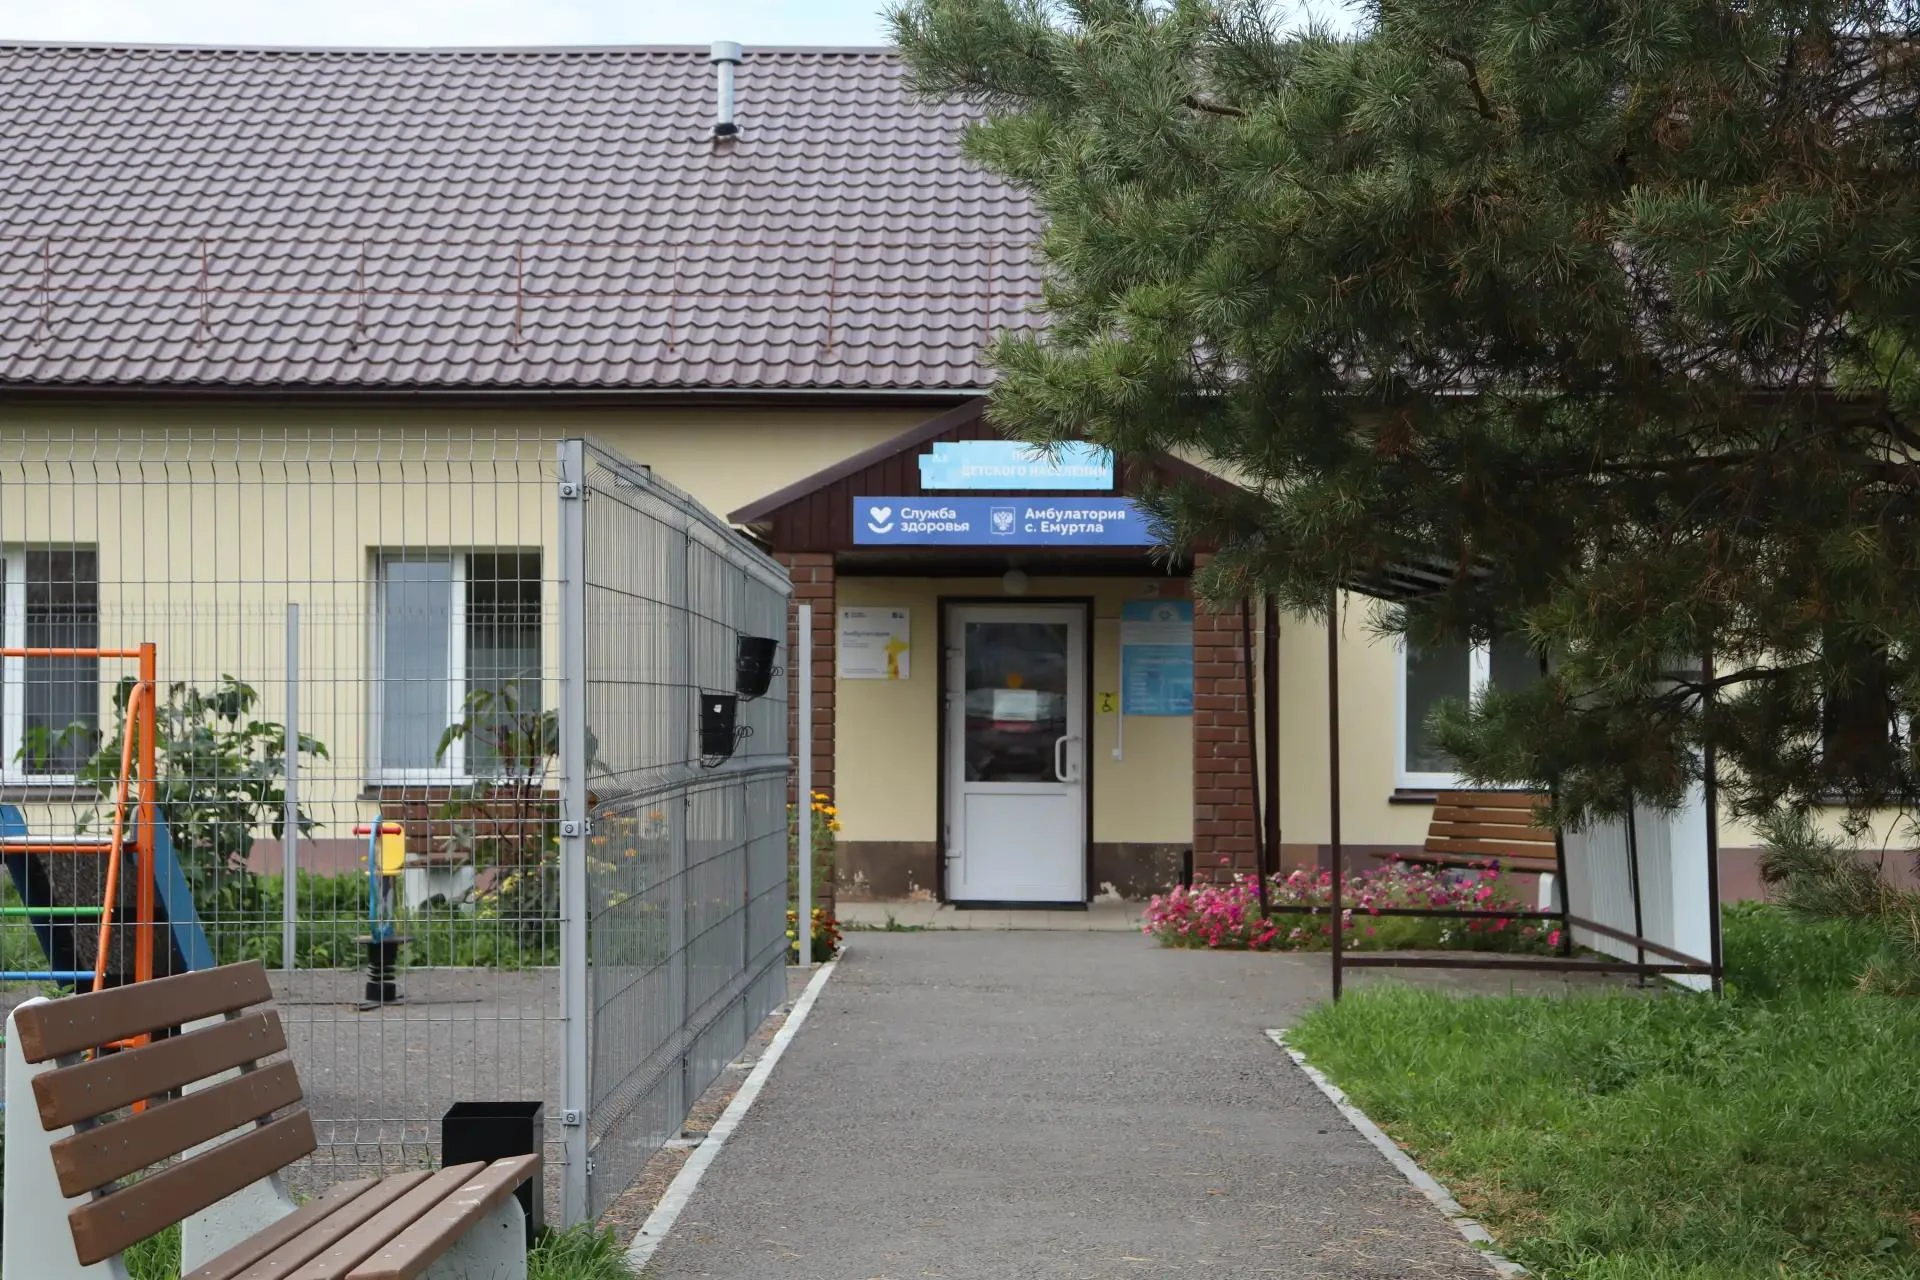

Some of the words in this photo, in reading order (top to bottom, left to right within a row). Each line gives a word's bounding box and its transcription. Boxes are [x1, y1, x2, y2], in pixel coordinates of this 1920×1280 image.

[962, 465, 1026, 477] ДЕТСКОГО
[901, 508, 956, 522] Служба
[1025, 508, 1125, 523] Амбулатория
[901, 521, 969, 534] здоровья
[1025, 524, 1036, 533] с.
[1041, 522, 1104, 536] Емуртла
